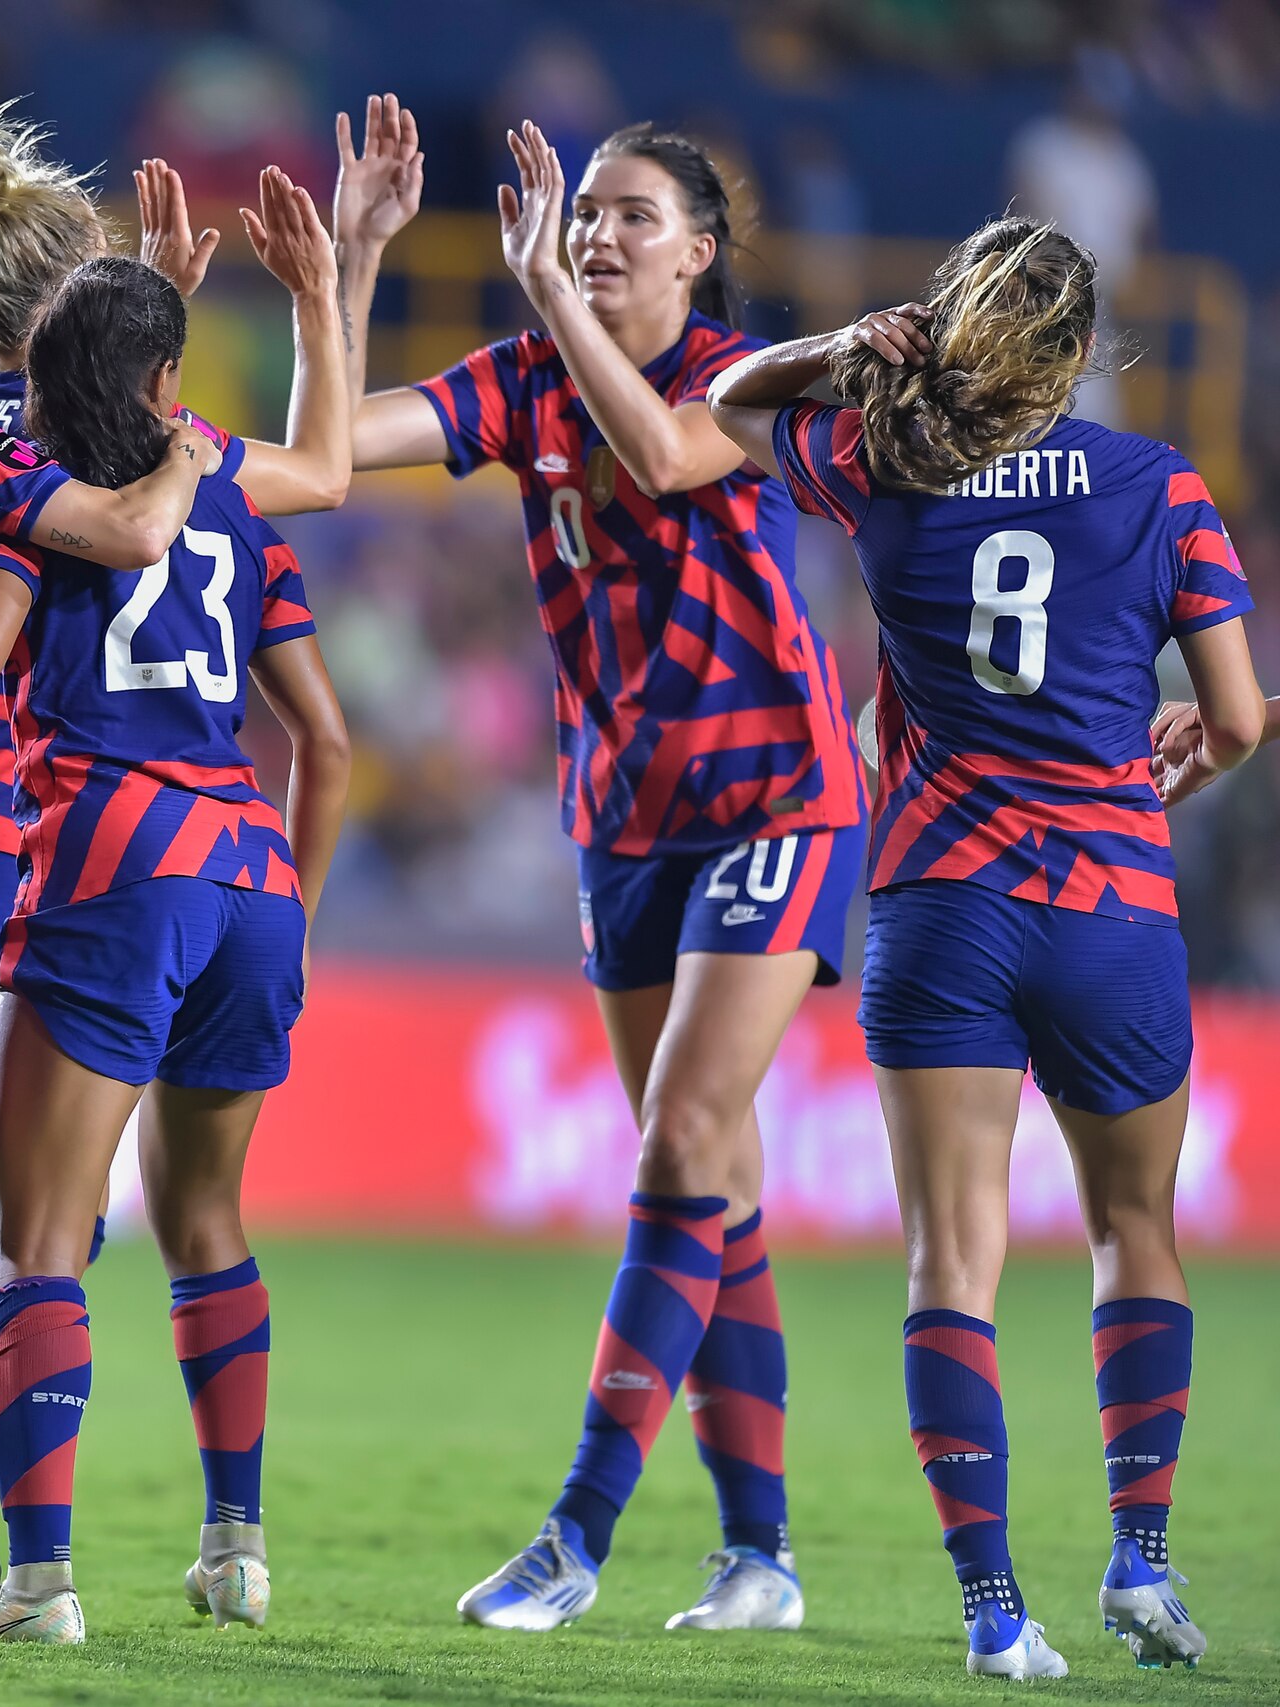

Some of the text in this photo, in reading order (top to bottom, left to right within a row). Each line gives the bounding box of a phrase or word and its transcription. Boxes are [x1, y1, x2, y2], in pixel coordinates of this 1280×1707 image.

[105, 525, 238, 703] 23
[966, 530, 1055, 696] 8
[705, 833, 799, 902] 20
